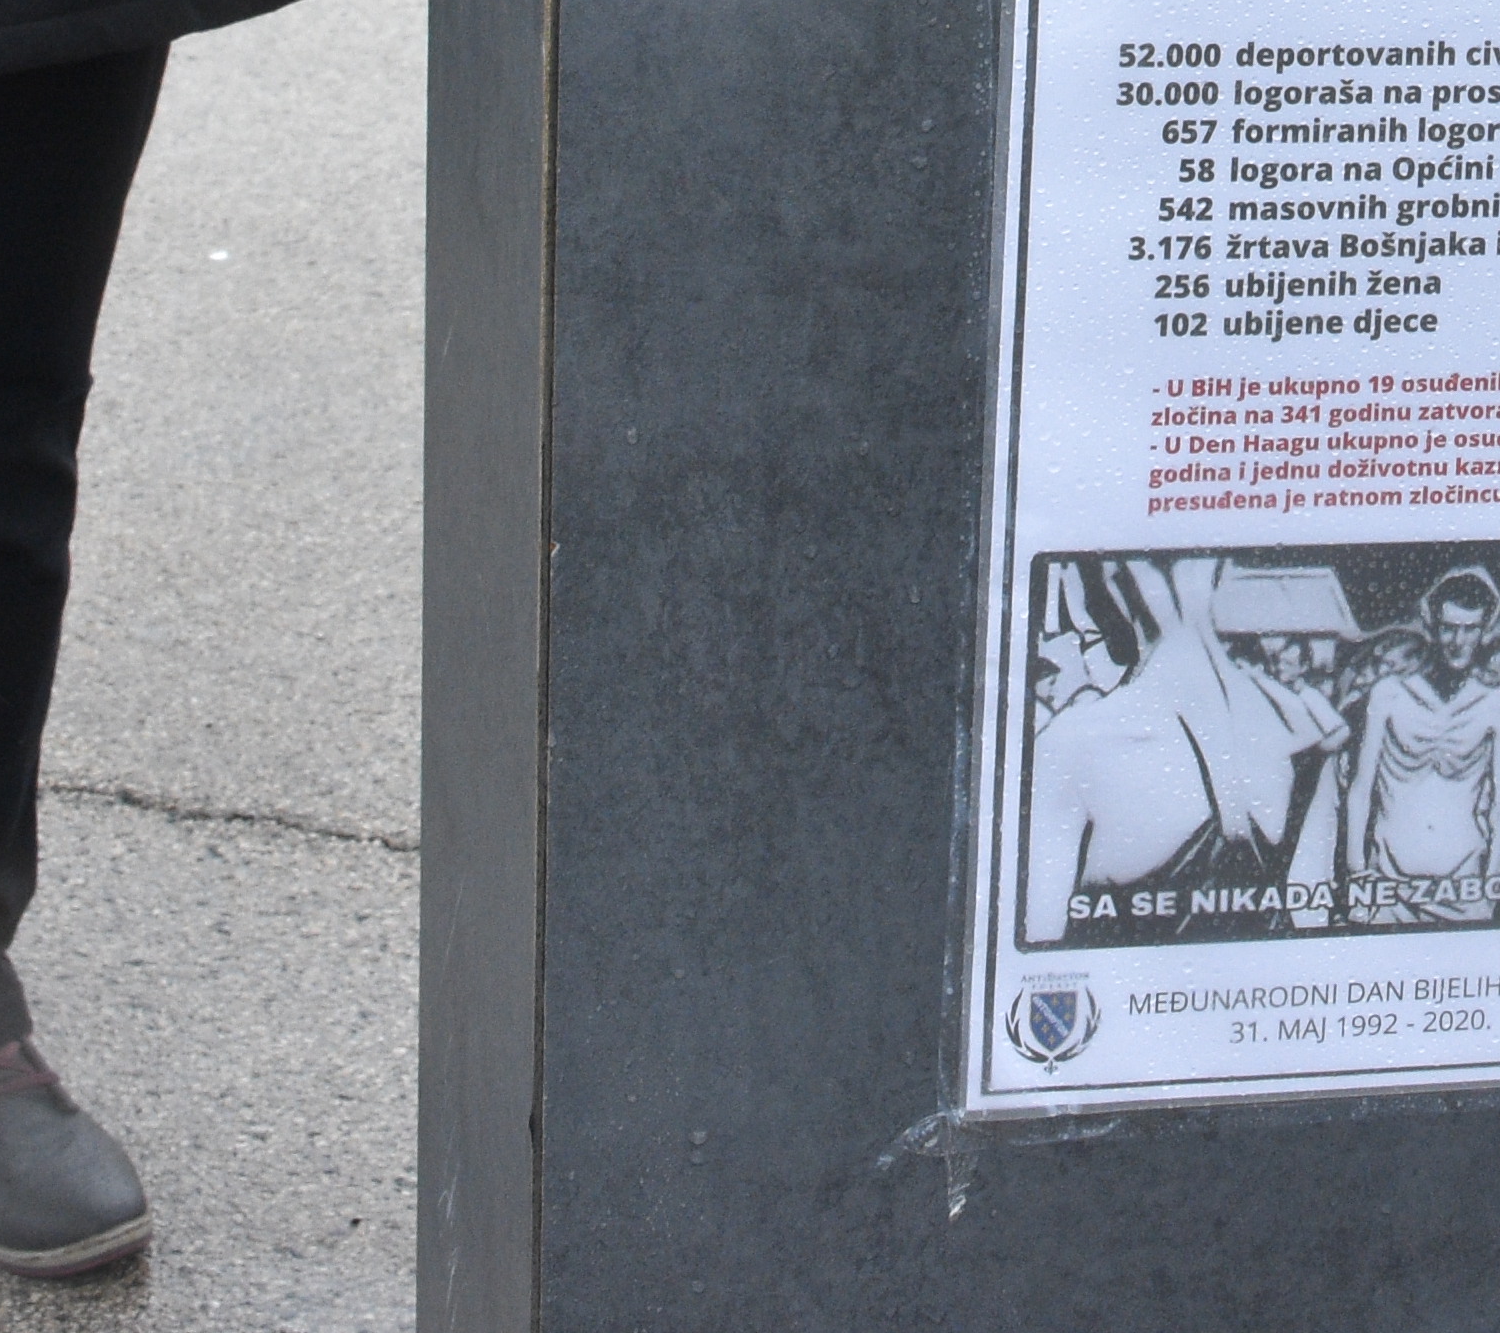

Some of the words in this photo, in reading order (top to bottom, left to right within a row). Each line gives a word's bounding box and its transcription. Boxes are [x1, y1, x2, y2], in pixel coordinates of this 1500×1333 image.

[1119, 42, 1222, 68] 52.000
[1235, 40, 1456, 75] deportovanih
[1116, 81, 1219, 106] 30.000
[1234, 79, 1373, 113] logoraša
[1383, 85, 1422, 105] na
[1162, 119, 1218, 145] 657
[1231, 116, 1408, 144] formiranih
[1179, 158, 1215, 183] 58
[1230, 156, 1333, 190] logora
[1343, 161, 1382, 182] na
[1392, 154, 1494, 189] Općini
[1158, 196, 1213, 222] 542
[1228, 193, 1387, 221] masovnih
[1128, 235, 1212, 261] 3.176
[1226, 233, 1329, 260] žrtava
[1340, 230, 1486, 264] Bošnjaka
[1154, 273, 1210, 299] 256
[1225, 270, 1357, 305] ubijenih
[1366, 269, 1442, 296] žena
[1154, 312, 1208, 337] 102
[1223, 309, 1344, 343] ubijene
[1353, 307, 1438, 341] djece
[1167, 379, 1184, 398] U
[1191, 377, 1232, 397] BiH
[1236, 376, 1261, 402] je
[1268, 375, 1361, 401] ukupno
[1368, 375, 1395, 394] 19
[1151, 405, 1237, 427] zločina
[1244, 409, 1274, 425] na
[1280, 404, 1321, 424] 341
[1328, 402, 1411, 429] godinu
[1165, 436, 1181, 455] U
[1189, 435, 1236, 454] Den
[1243, 434, 1320, 457] Haagu
[1326, 431, 1419, 455] ukupno
[1423, 429, 1447, 454] je
[1148, 462, 1231, 490] godina
[1239, 461, 1246, 481] i
[1249, 460, 1321, 486] jednu
[1327, 458, 1448, 479] doživotnu
[1147, 489, 1278, 516] presuđena
[1282, 488, 1306, 514] je
[1313, 489, 1403, 507] ratnom
[1068, 893, 1118, 920] SA
[1130, 890, 1178, 918] SE
[1190, 882, 1336, 916] NIKADA
[1346, 881, 1397, 908] NE
[1129, 983, 1338, 1016] MEĐUNARODNI
[1347, 980, 1405, 1004] DAN
[1229, 1021, 1268, 1044] 31.
[1278, 1016, 1327, 1044] MAJ
[1337, 1012, 1398, 1038] 1992
[1422, 1009, 1491, 1033] 2020.
